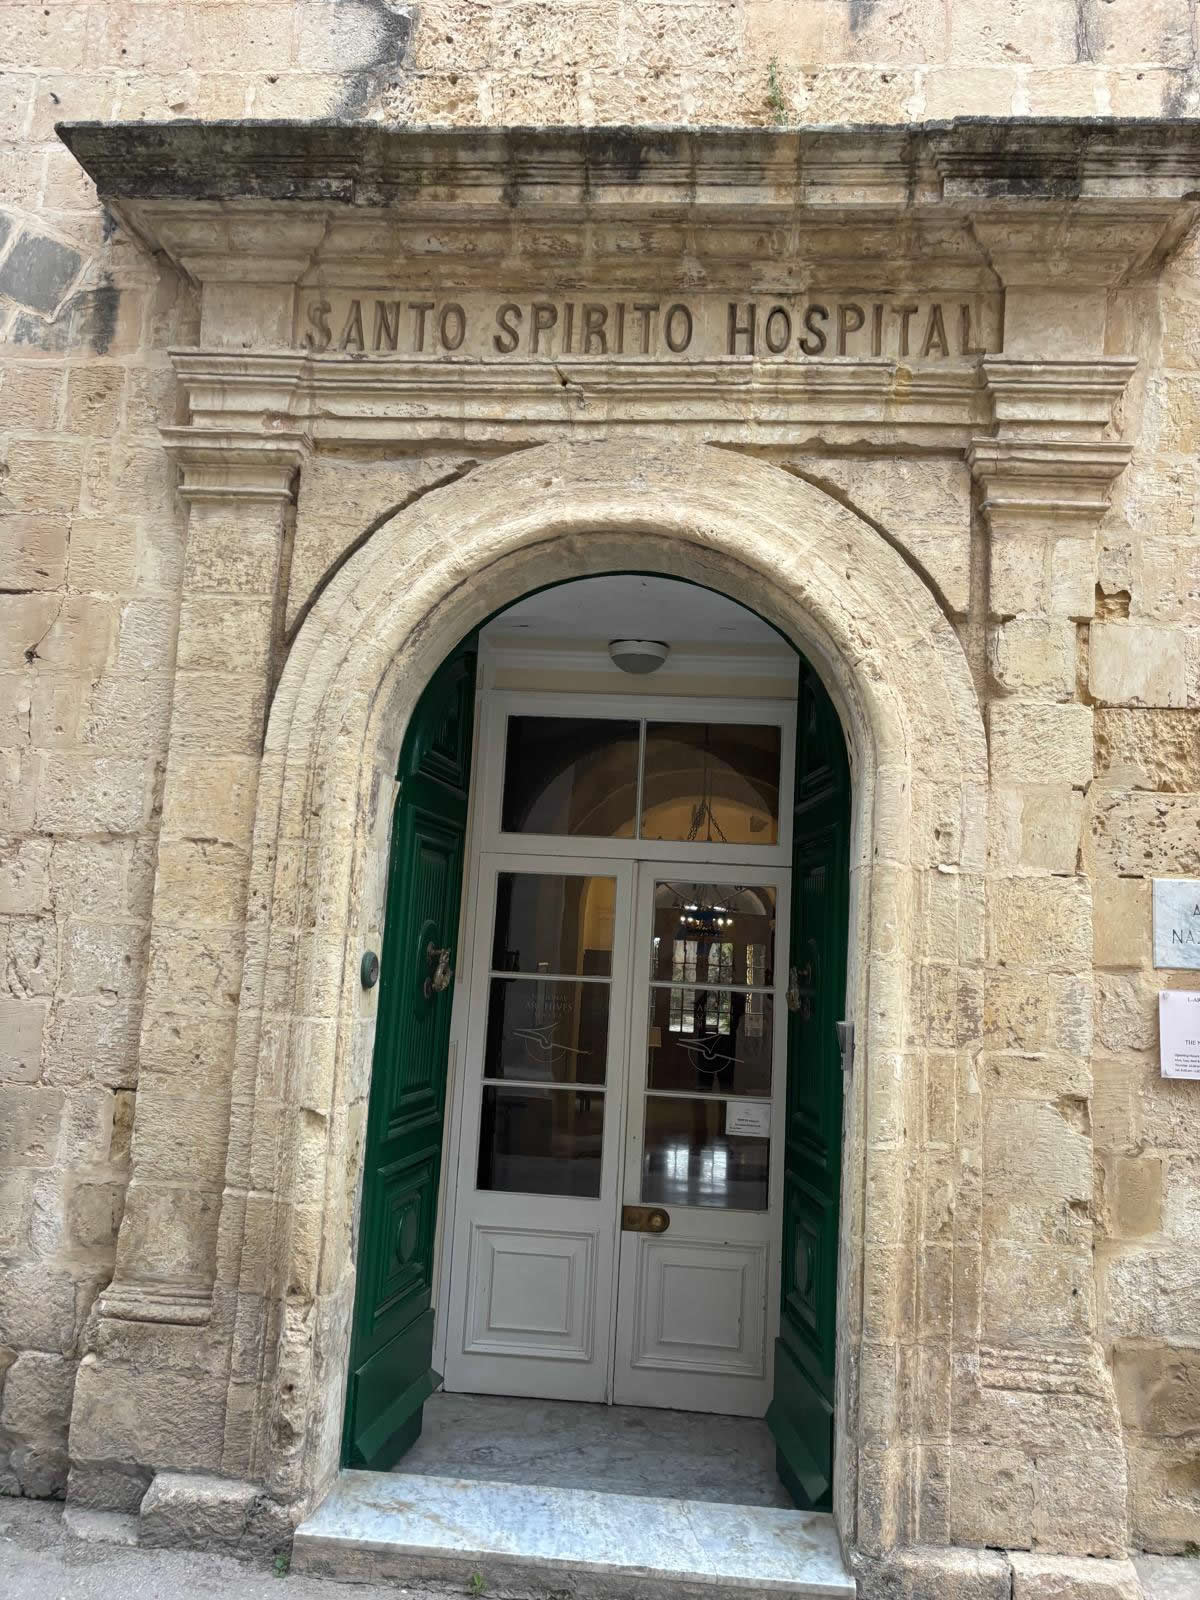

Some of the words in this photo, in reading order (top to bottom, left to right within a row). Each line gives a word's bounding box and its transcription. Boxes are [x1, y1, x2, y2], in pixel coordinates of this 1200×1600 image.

[305, 300, 467, 352] SANTO
[493, 303, 693, 354] SPIRITO
[727, 303, 986, 356] HOSPITAL
